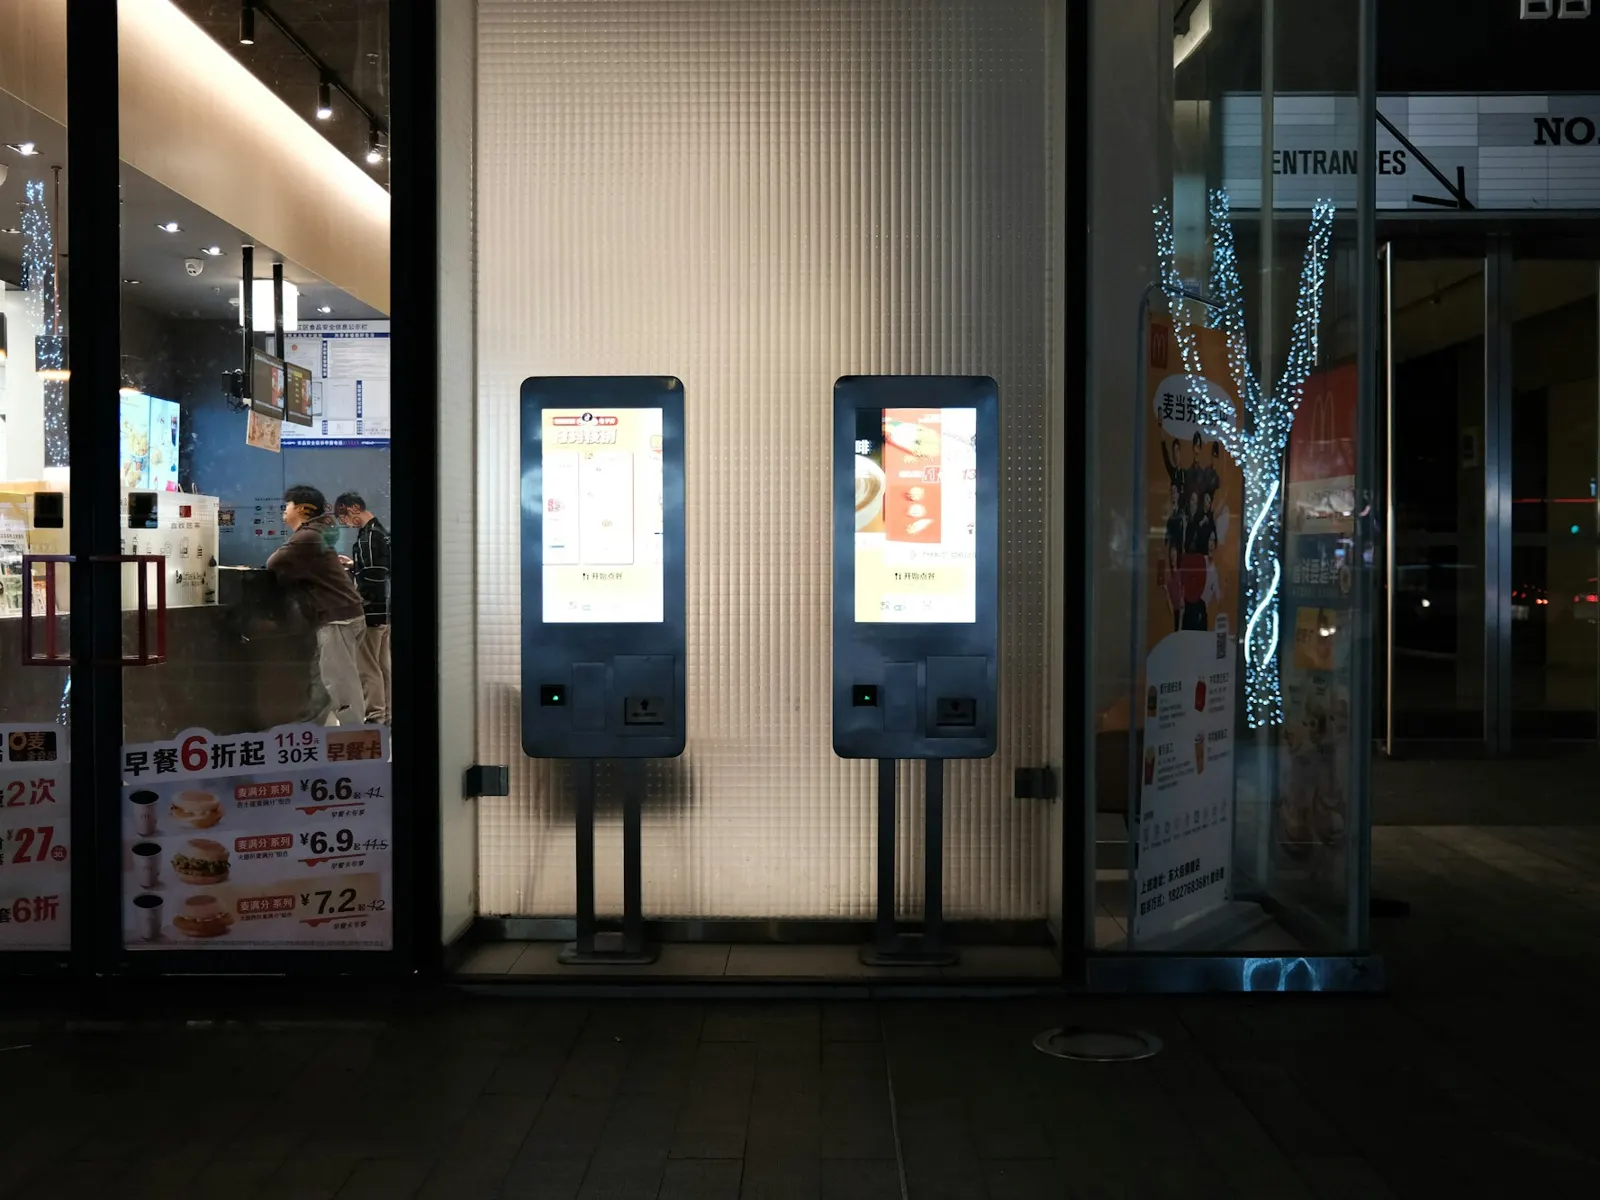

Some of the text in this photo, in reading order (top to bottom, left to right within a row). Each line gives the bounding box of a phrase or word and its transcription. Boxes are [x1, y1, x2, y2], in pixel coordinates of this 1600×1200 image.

[124, 736, 265, 776] 早餐6折起
[278, 747, 318, 764] 30天
[327, 742, 382, 761] 早餐卡
